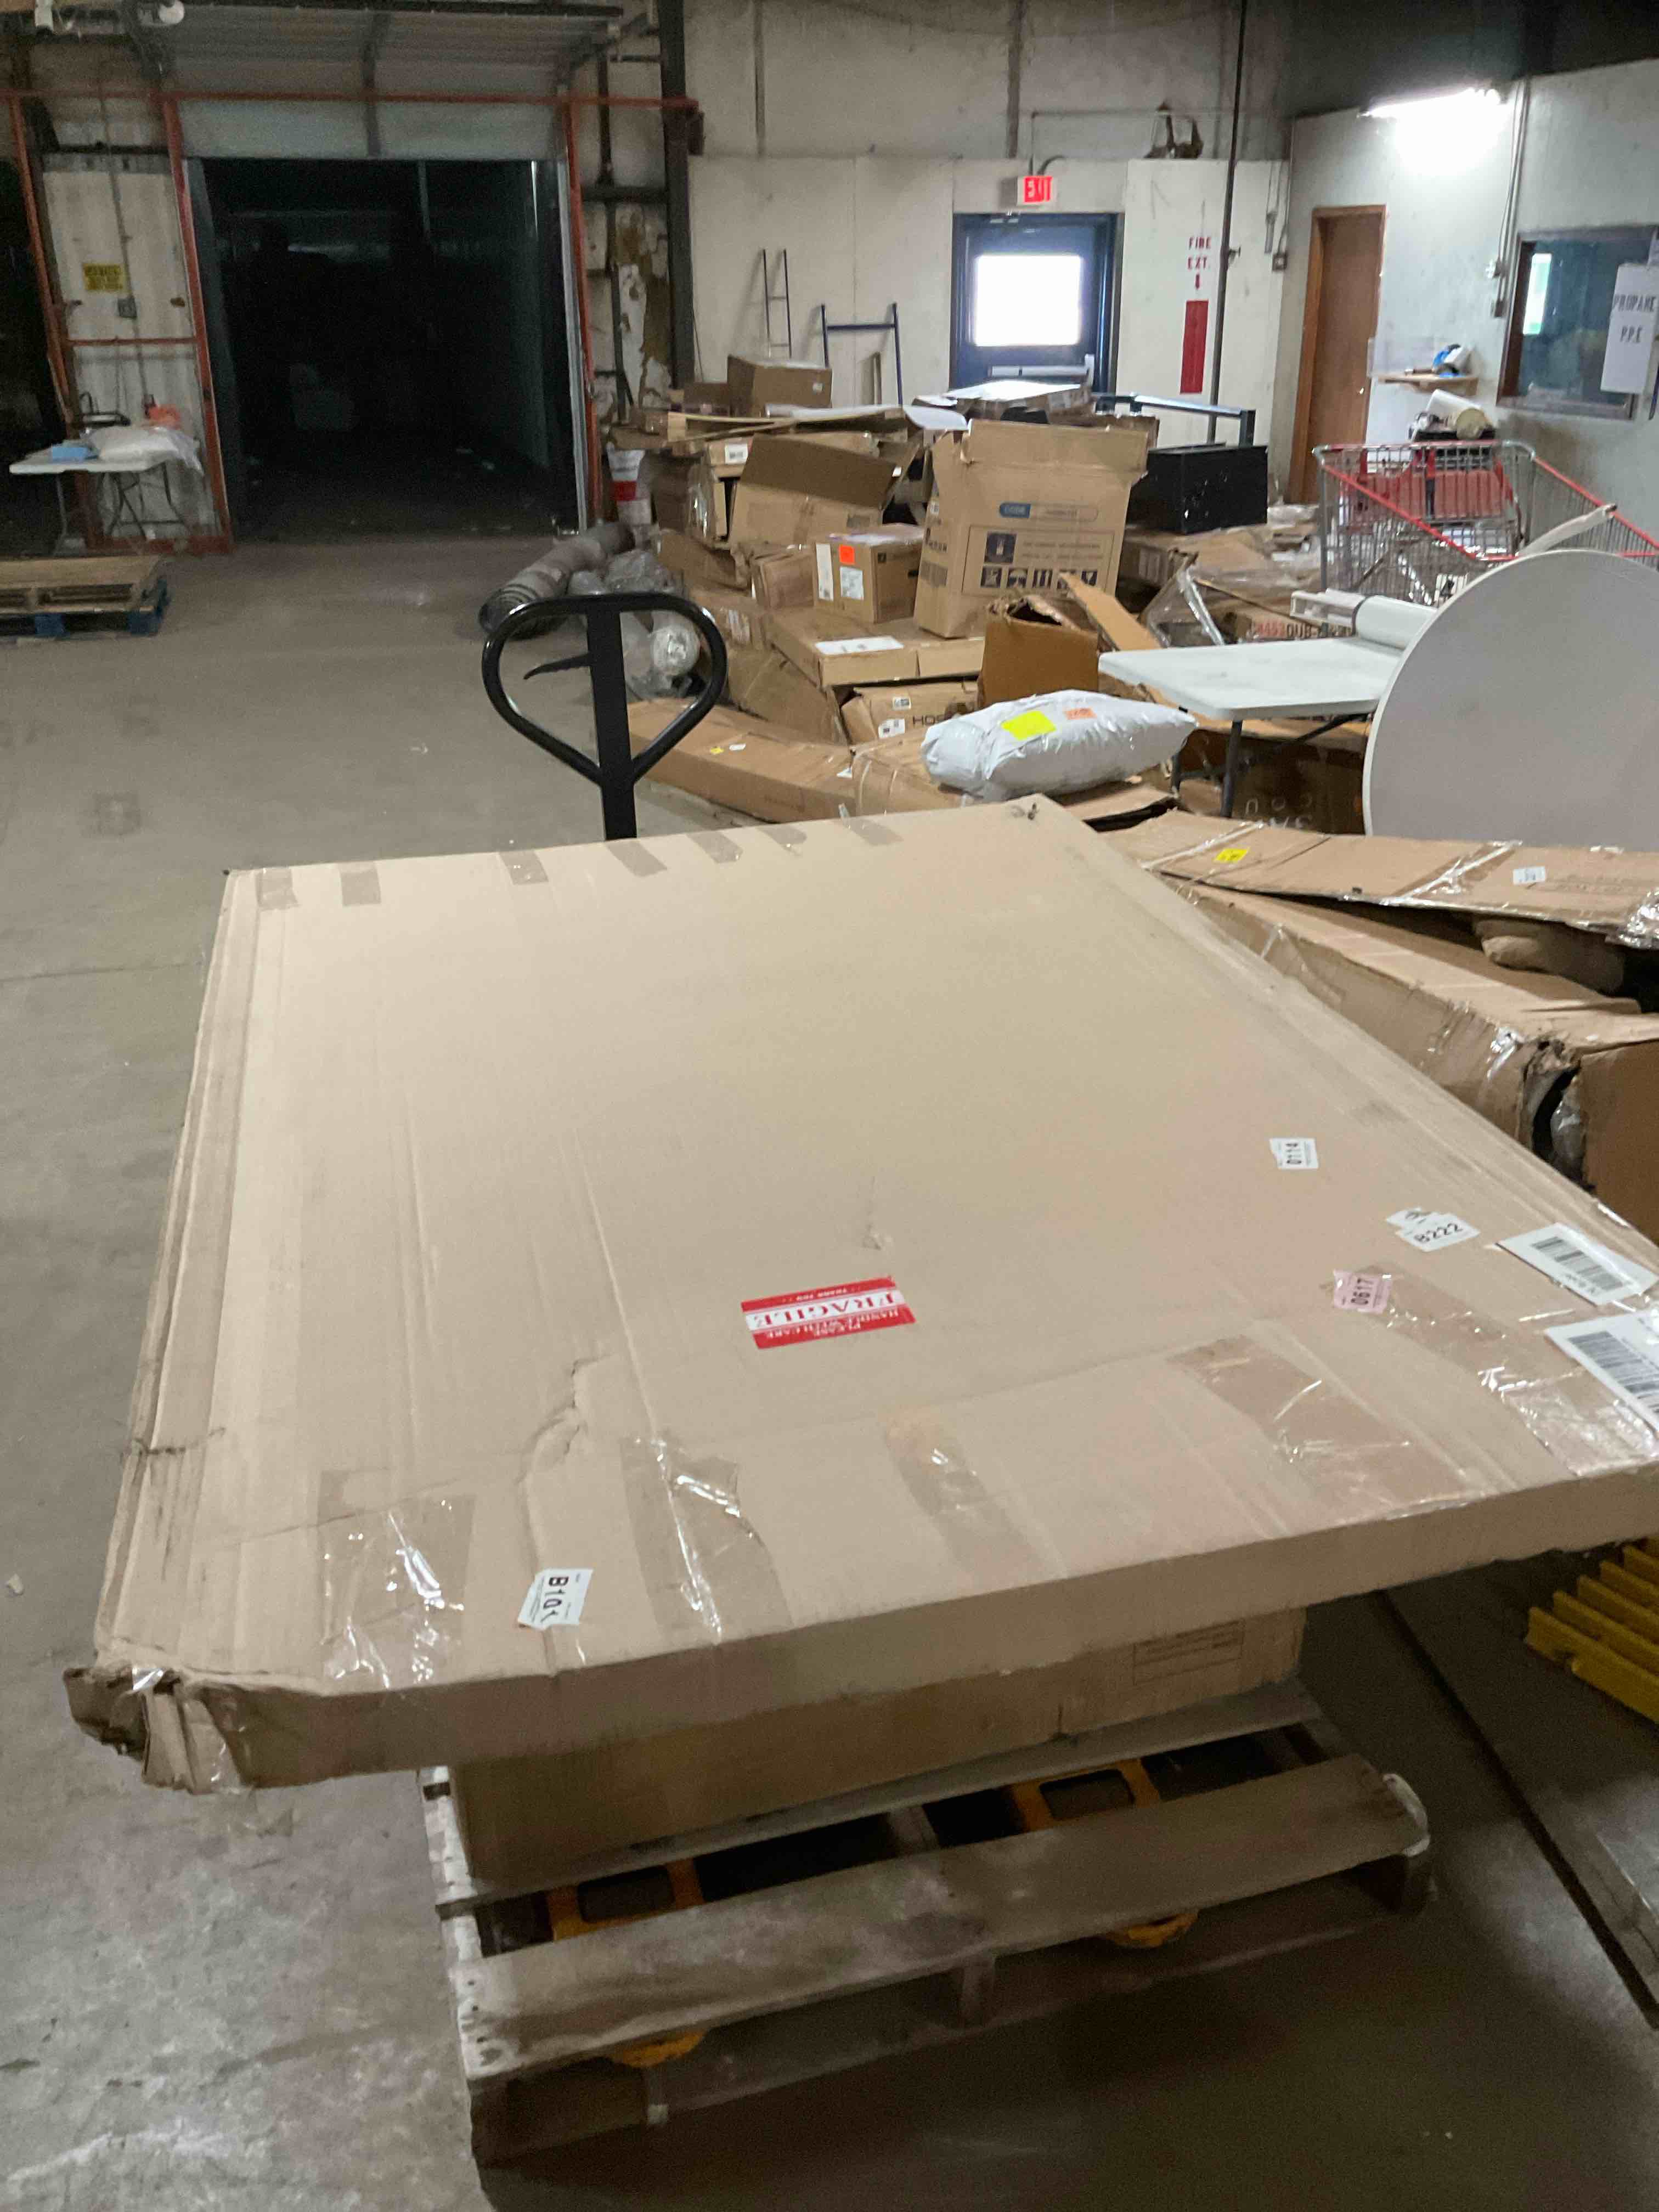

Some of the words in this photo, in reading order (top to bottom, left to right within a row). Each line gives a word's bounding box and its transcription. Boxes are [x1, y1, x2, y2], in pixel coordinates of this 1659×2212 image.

[1024, 176, 1053, 202] EXIT
[1189, 236, 1211, 250] FIRE
[1614, 295, 1656, 312] PROPANE
[754, 1293, 894, 1325] FRAGILE
